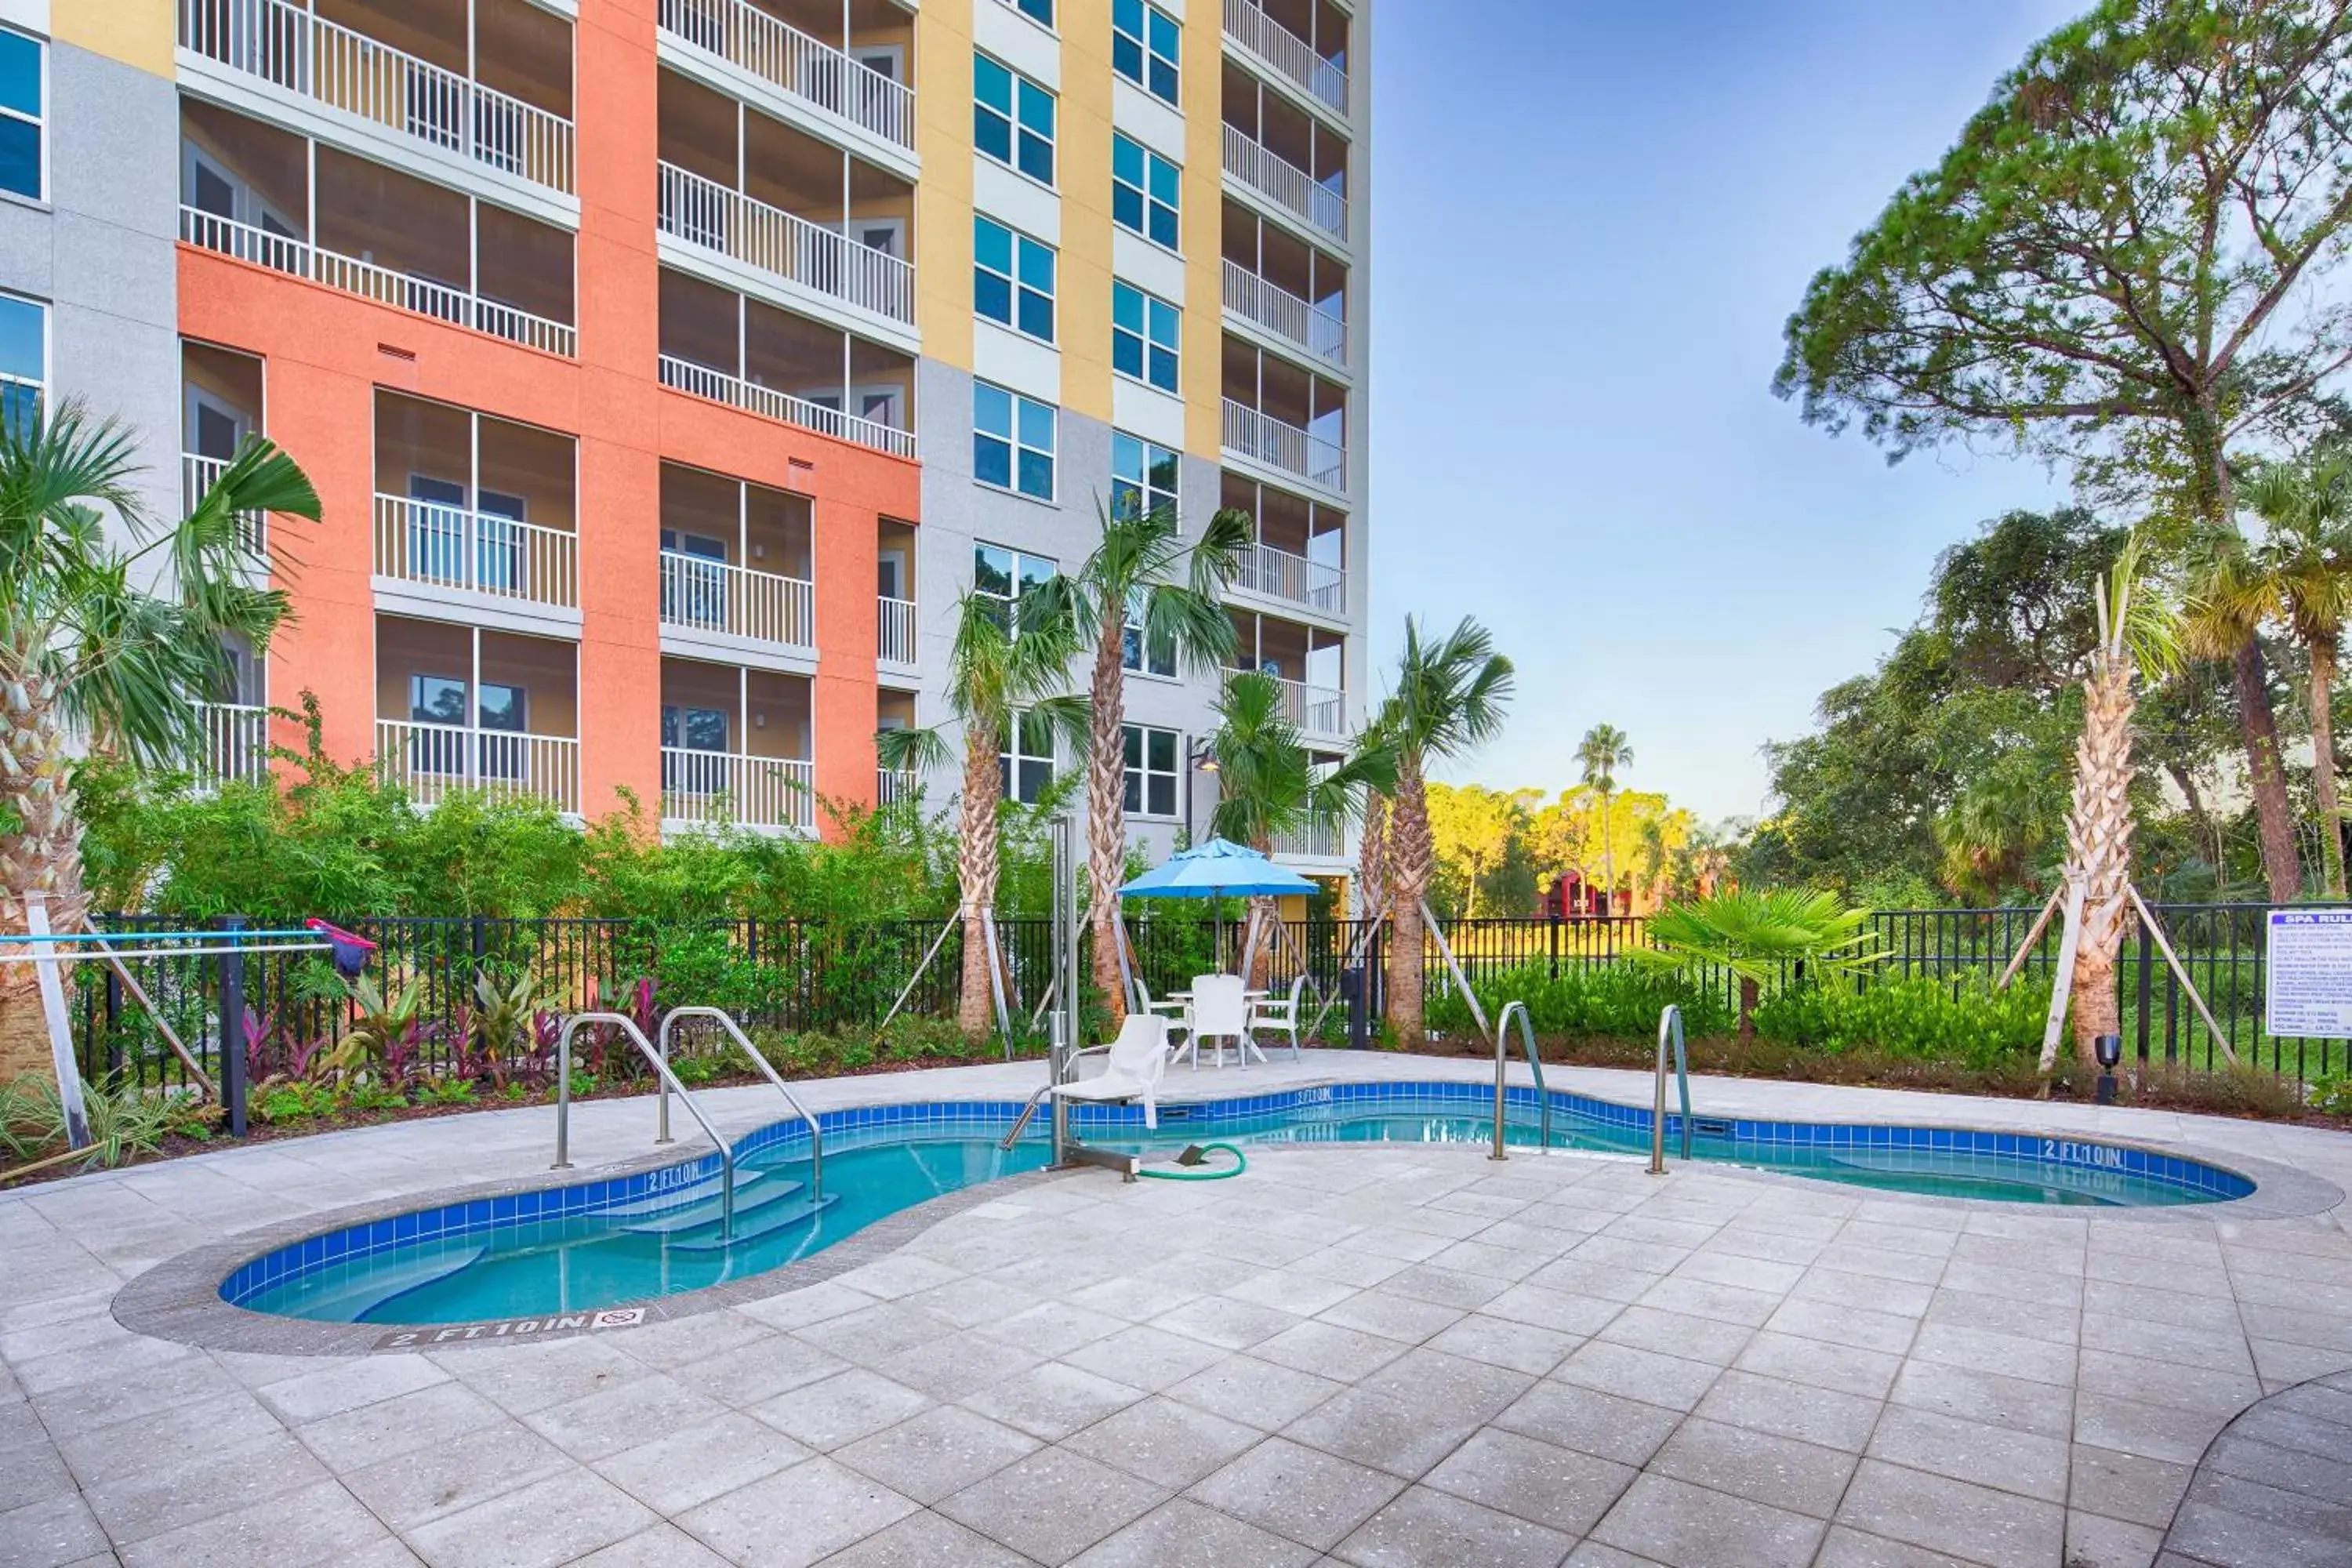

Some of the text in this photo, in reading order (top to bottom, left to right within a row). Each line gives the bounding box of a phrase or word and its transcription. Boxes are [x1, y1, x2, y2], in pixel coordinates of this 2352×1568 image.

[2045, 1140, 2055, 1157] 2
[649, 1173, 657, 1192] 2
[389, 1334, 419, 1347] 2
